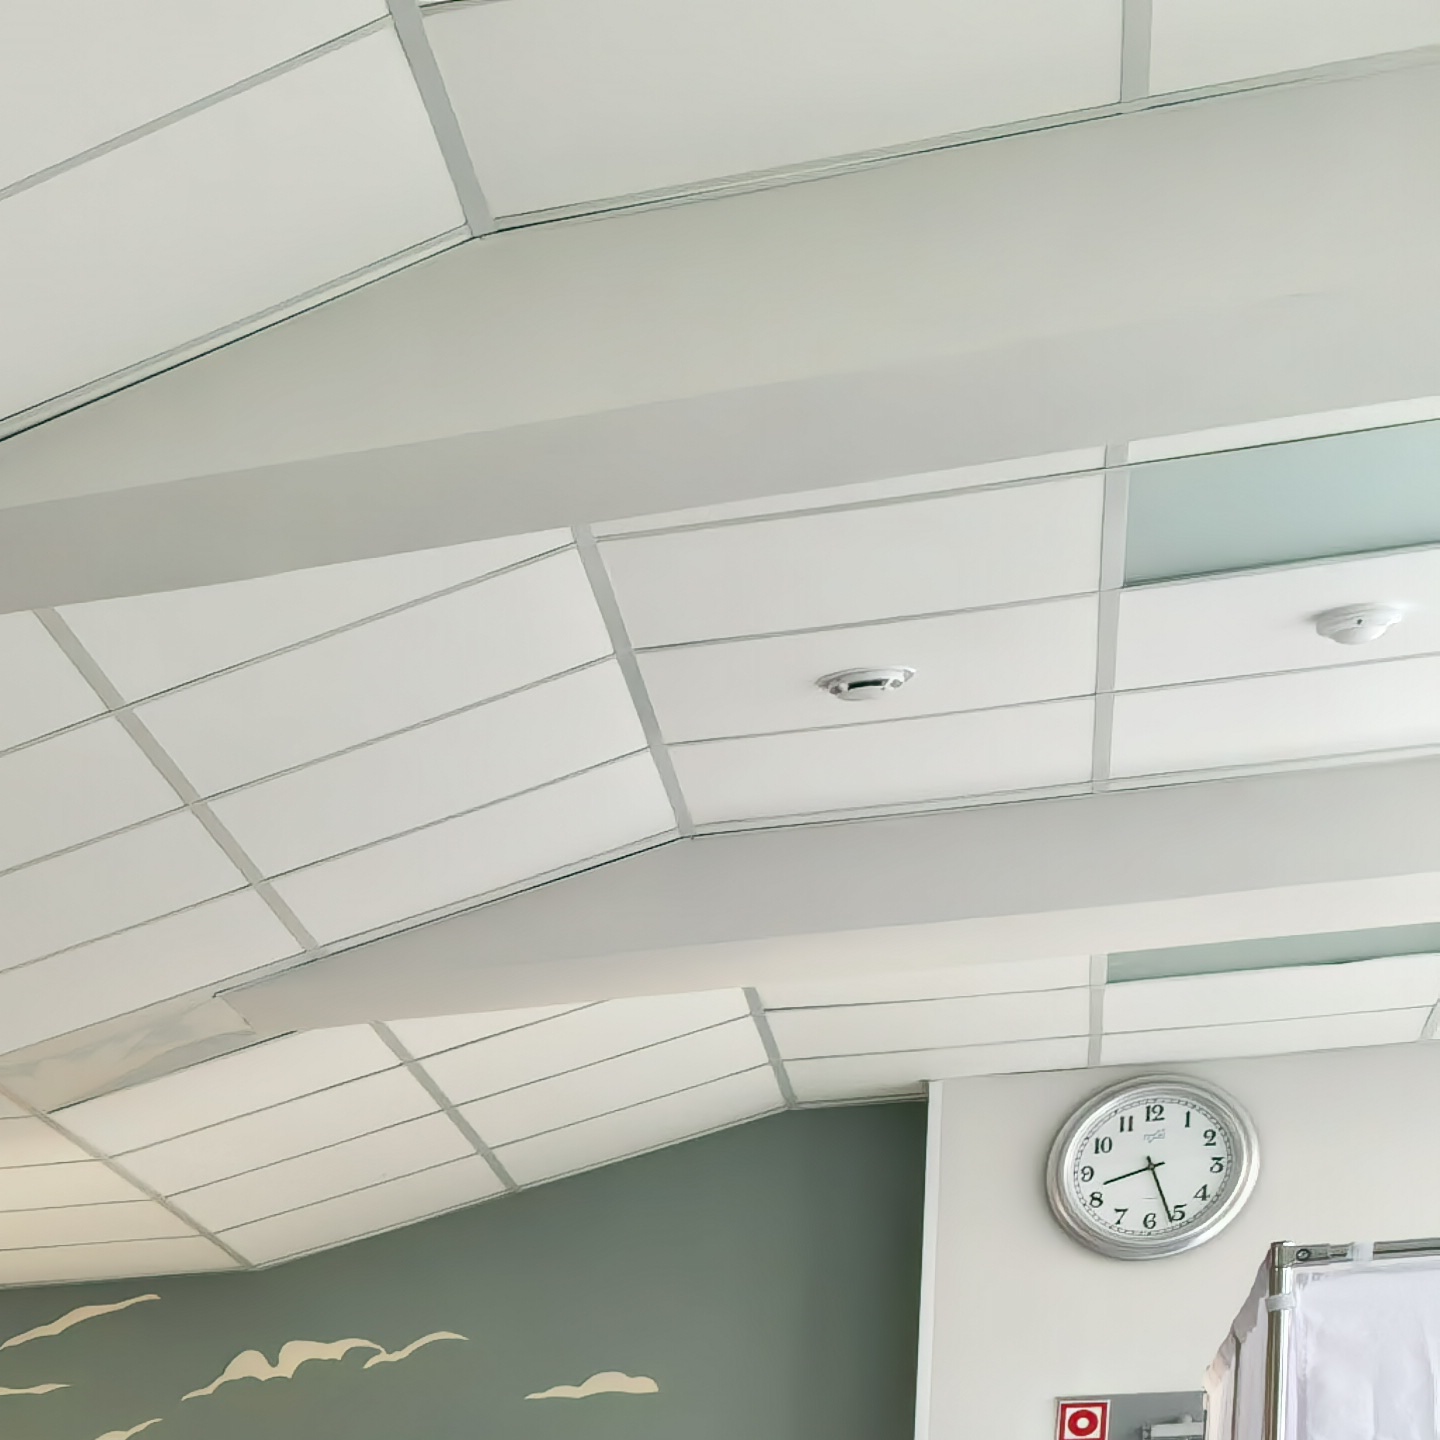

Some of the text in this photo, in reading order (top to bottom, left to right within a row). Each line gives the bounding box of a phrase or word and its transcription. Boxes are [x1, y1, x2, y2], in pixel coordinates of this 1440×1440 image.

[1145, 1104, 1165, 1122] 12
[1184, 1111, 1191, 1128] 1
[1119, 1115, 1134, 1132] 11
[1094, 1137, 1113, 1154] 10
[1203, 1129, 1217, 1147] 2
[1210, 1156, 1224, 1174] 3
[1080, 1166, 1094, 1183] 9
[1089, 1191, 1104, 1208] 8
[1194, 1184, 1211, 1202] 4
[1114, 1208, 1129, 1225] 7
[1143, 1213, 1156, 1230] 6
[1172, 1204, 1187, 1222] 5
